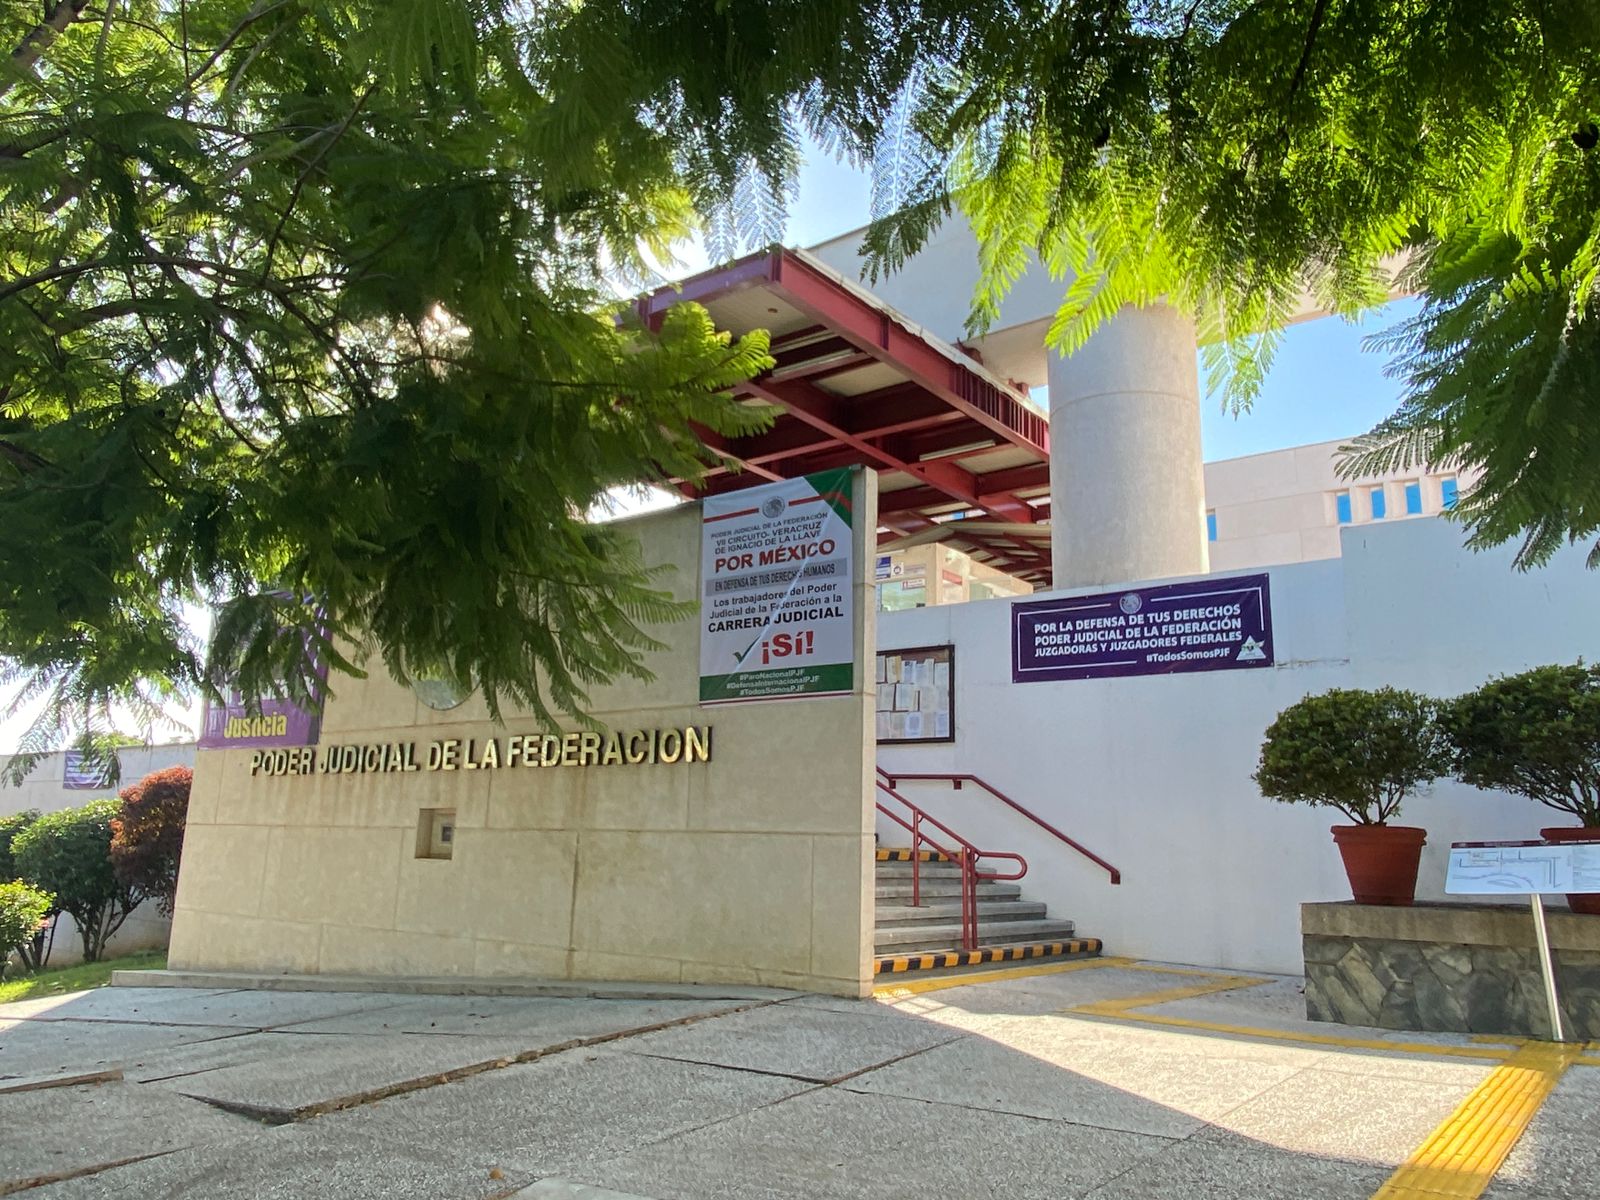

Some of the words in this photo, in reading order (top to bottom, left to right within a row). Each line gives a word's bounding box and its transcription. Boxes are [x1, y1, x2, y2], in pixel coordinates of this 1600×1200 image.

[711, 530, 732, 539] PODER
[734, 525, 761, 534] JUDICIAL
[772, 520, 782, 528] LA
[783, 512, 828, 526] FEDERACIÓN
[716, 539, 726, 547] VII
[772, 521, 821, 537] VERACRUZ
[715, 547, 726, 555] DE
[728, 540, 763, 552] IGNACIO
[765, 538, 777, 546] DE
[779, 535, 791, 544] LA
[715, 553, 754, 574] POR
[759, 539, 836, 566] MÉXICO
[715, 580, 723, 592] EN
[723, 577, 750, 590] DEFENSA
[750, 575, 758, 587] DE
[758, 573, 770, 585] TUS
[803, 563, 835, 577] HUMANOS
[709, 607, 743, 619] Judicial
[745, 606, 756, 615] de
[758, 604, 767, 613] la
[823, 596, 831, 604] a
[833, 593, 842, 603] la
[713, 599, 730, 608] Los
[790, 586, 805, 597] del
[807, 583, 837, 594] Poder
[708, 616, 771, 633] CARRERA
[774, 606, 844, 625] JUDICIAL
[1034, 623, 1057, 634] POR
[1059, 621, 1073, 632] LA
[1075, 616, 1126, 630] DEFENSA
[1128, 614, 1144, 625] DE
[1147, 611, 1171, 623] TUS
[1173, 603, 1241, 621] DERECHOS
[1034, 634, 1071, 647] PODER
[1073, 629, 1123, 643] JUDICIAL
[1125, 627, 1141, 639] DE
[1143, 626, 1159, 637] LA
[1162, 616, 1241, 635] FEDERACIÓN
[762, 630, 814, 665] ¡Sí!
[1034, 643, 1098, 657] JUZGADORAS
[1100, 642, 1107, 652] Y
[1109, 637, 1178, 652] JUZGADORES
[1180, 631, 1242, 646] FEDERALES
[1146, 647, 1230, 663] #TodosSomosPJF
[739, 668, 806, 681] #ParoNacionalPJF
[739, 684, 806, 696] #TodosSomosPJF
[250, 747, 314, 776] PODER
[319, 742, 418, 775] JUDICIAL
[426, 739, 459, 771] DE
[463, 738, 499, 769] LA
[505, 726, 711, 768] FEDERACION
